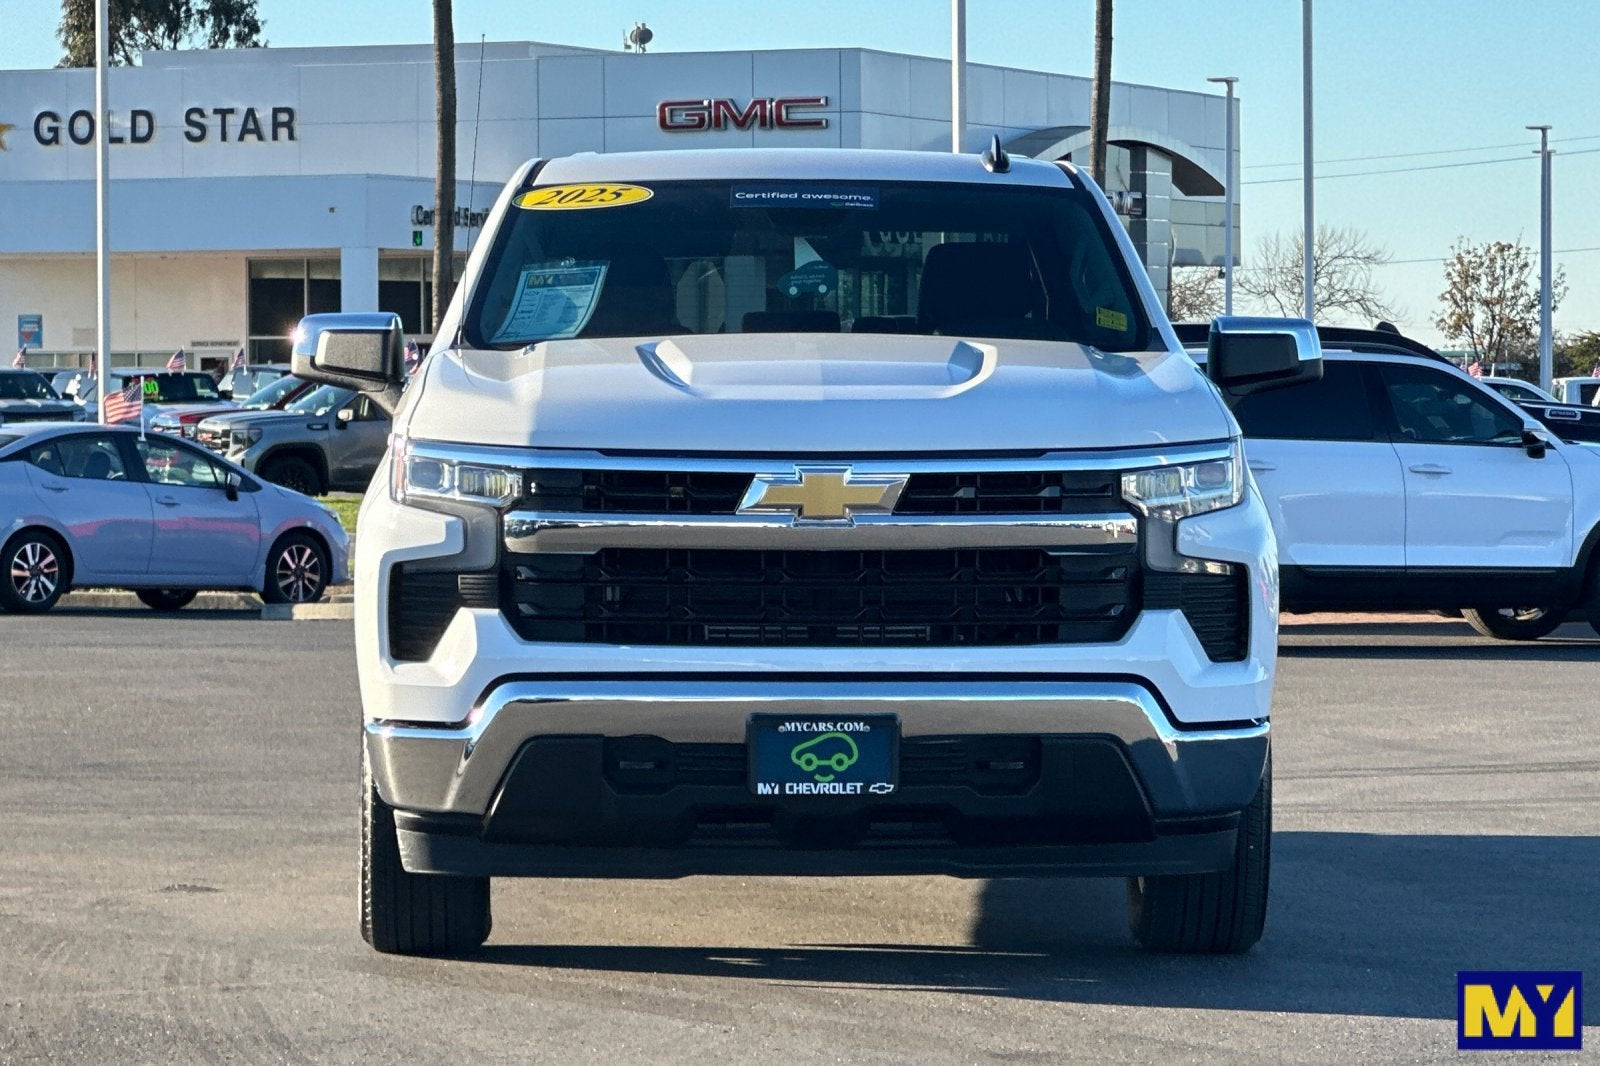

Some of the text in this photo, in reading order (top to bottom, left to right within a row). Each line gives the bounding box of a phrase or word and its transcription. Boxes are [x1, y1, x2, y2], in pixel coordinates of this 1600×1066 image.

[656, 96, 828, 133] GMC
[33, 106, 297, 146] GOLD STAR
[532, 187, 632, 206] 2025
[801, 193, 874, 201] awesome.
[784, 722, 864, 732] MYCARS.COM
[757, 782, 863, 795] MY CHEVROLET
